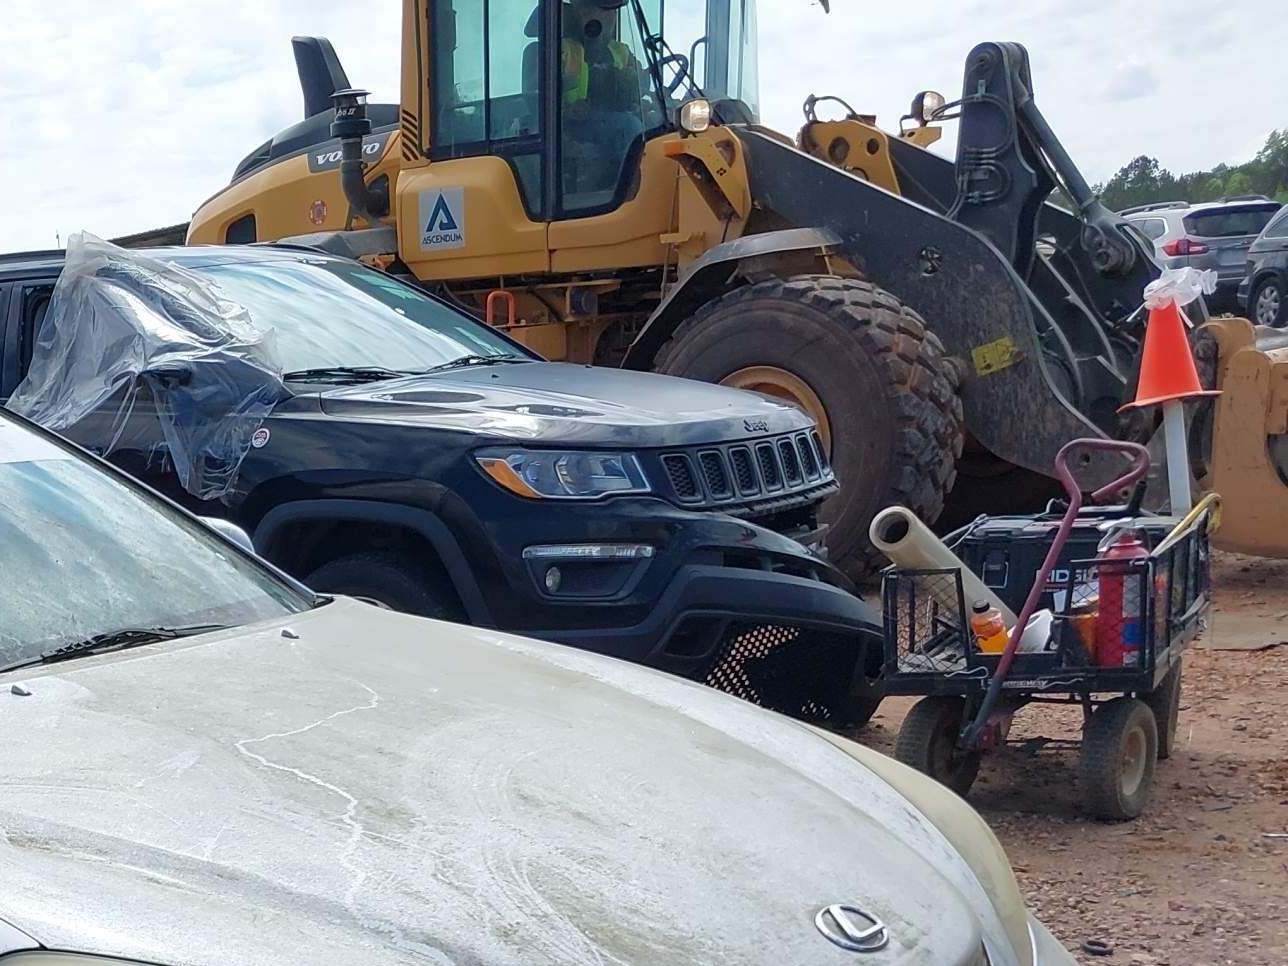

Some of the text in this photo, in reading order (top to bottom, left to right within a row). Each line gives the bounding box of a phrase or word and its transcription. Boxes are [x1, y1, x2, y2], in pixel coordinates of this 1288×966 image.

[316, 142, 380, 165] VOVO
[422, 232, 463, 245] ASCENDUM
[743, 419, 769, 433] Jeep
